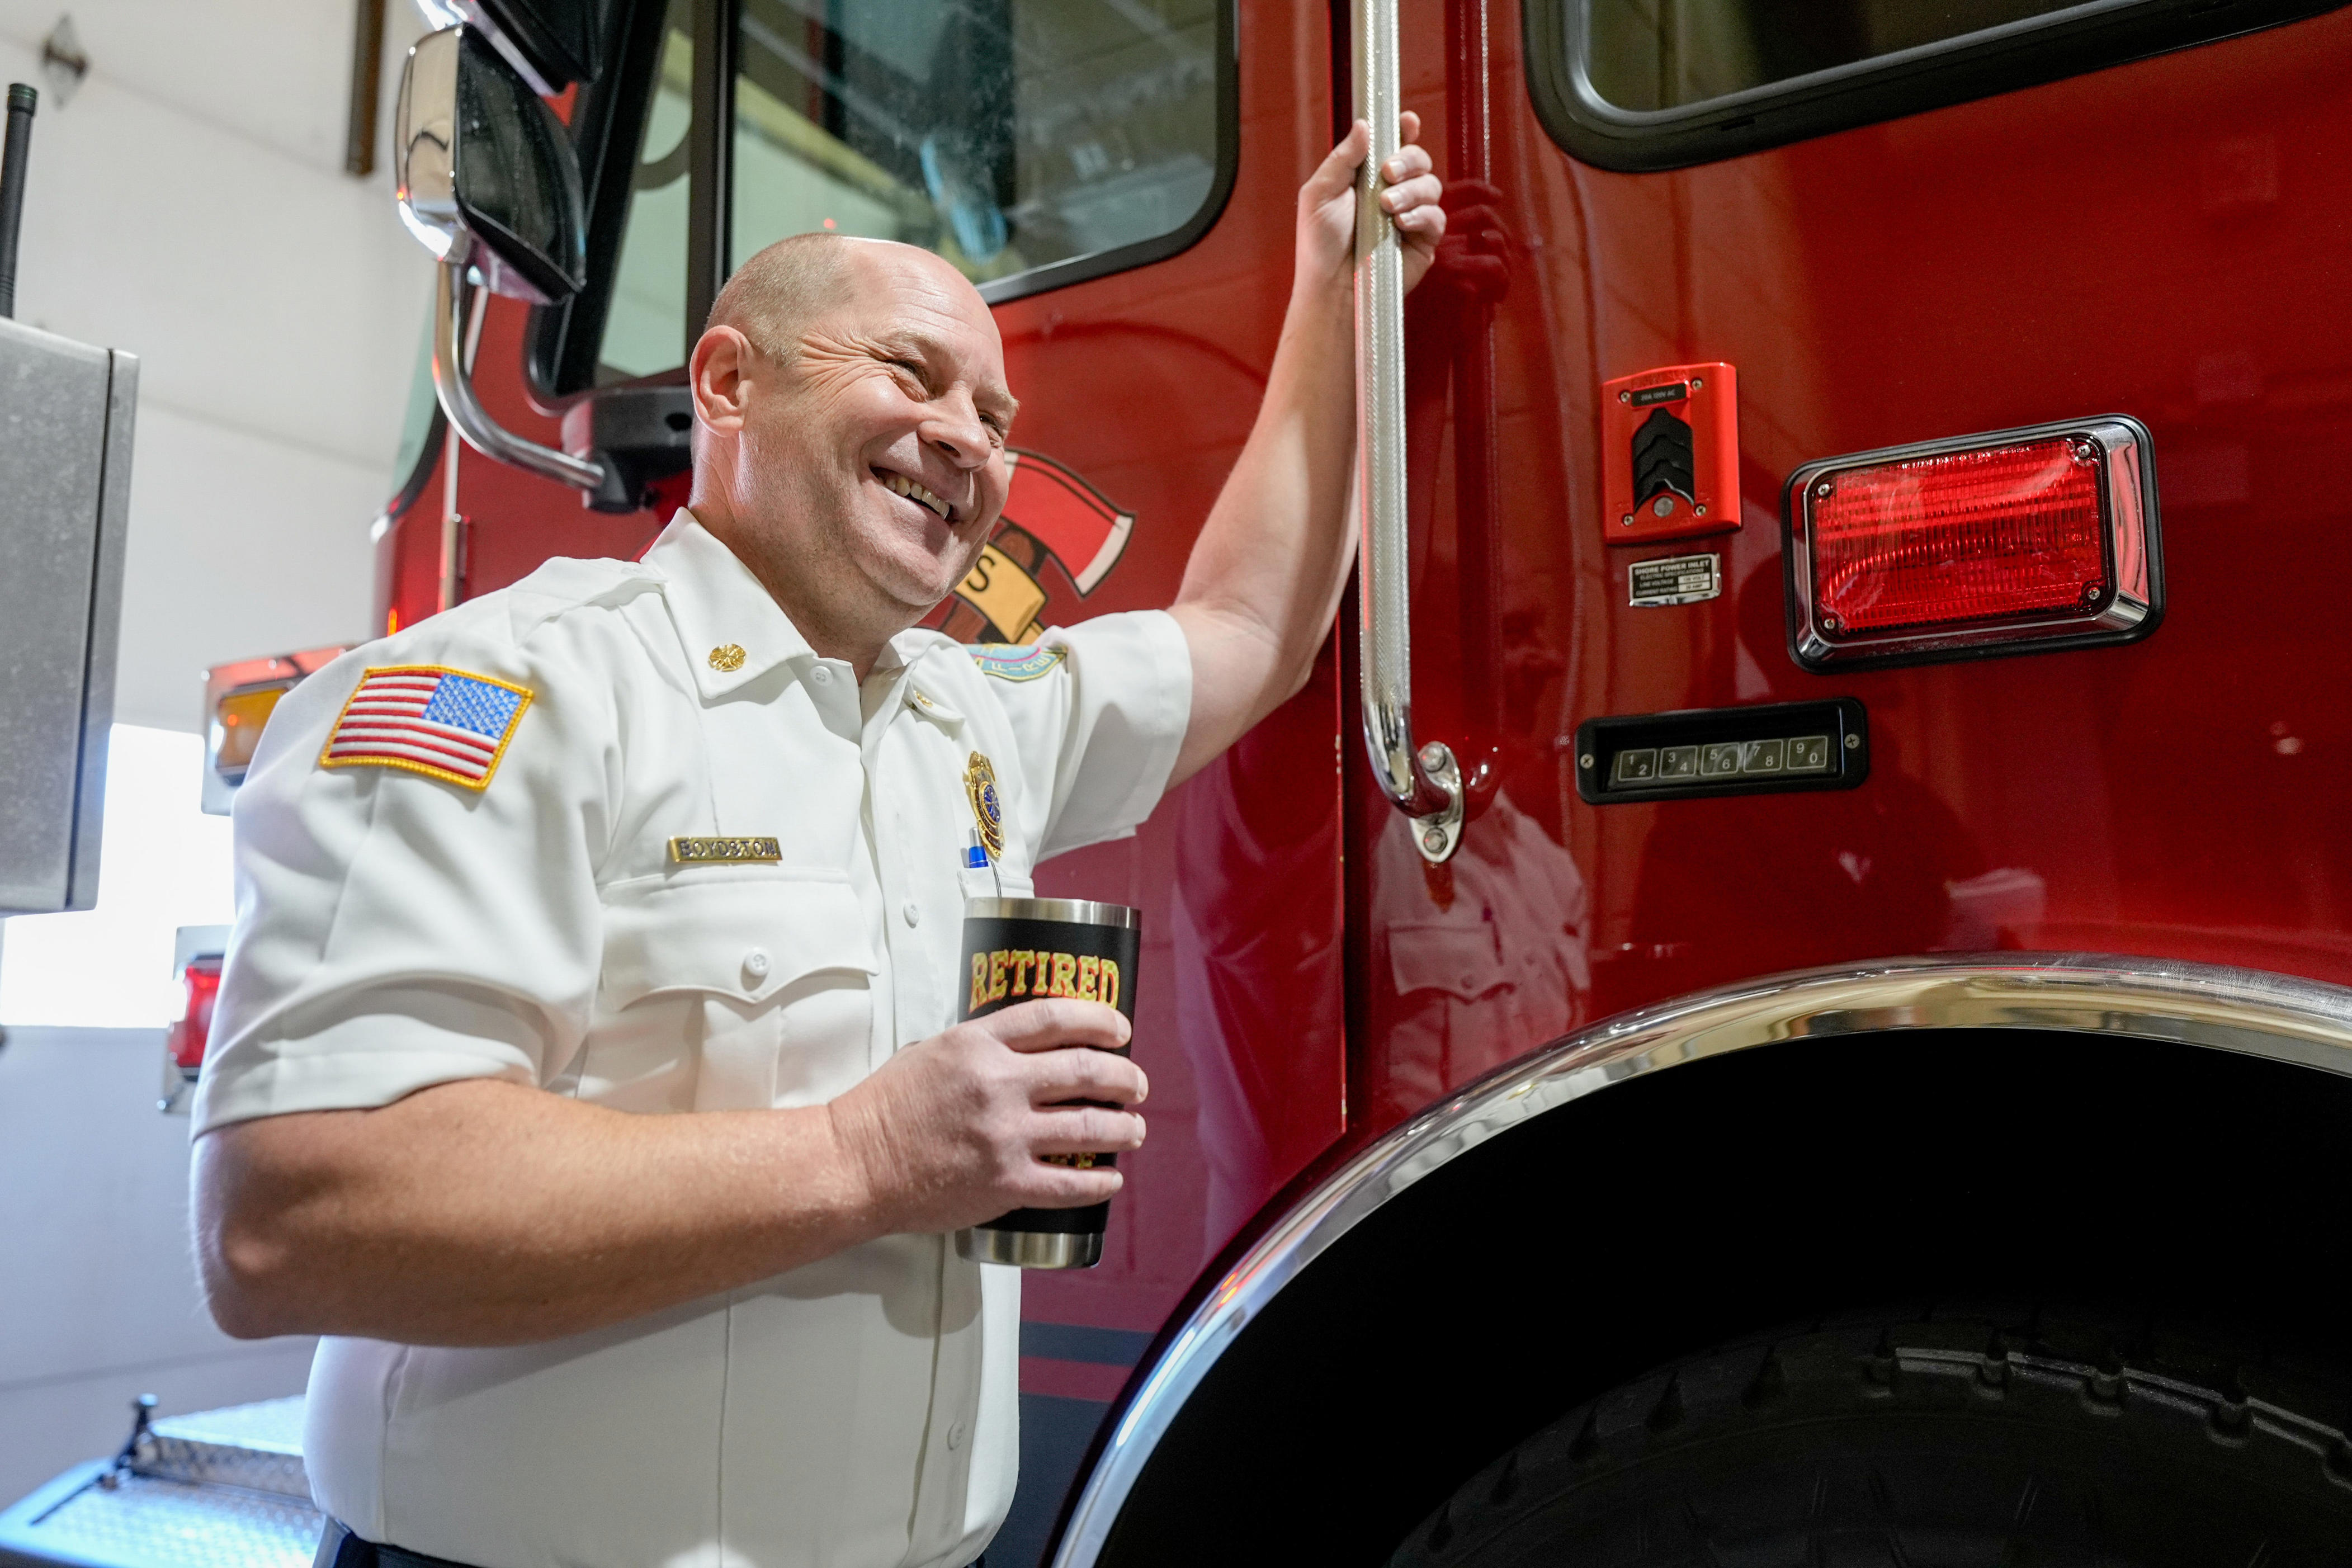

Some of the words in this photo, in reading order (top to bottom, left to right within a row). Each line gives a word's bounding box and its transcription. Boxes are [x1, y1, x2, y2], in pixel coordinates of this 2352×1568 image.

[1635, 567, 1659, 575] SHORE
[1660, 563, 1687, 572] POWER
[1688, 560, 1709, 568] INLET
[680, 840, 777, 856] BOYDSTON
[969, 949, 1120, 1014] RETIRED
